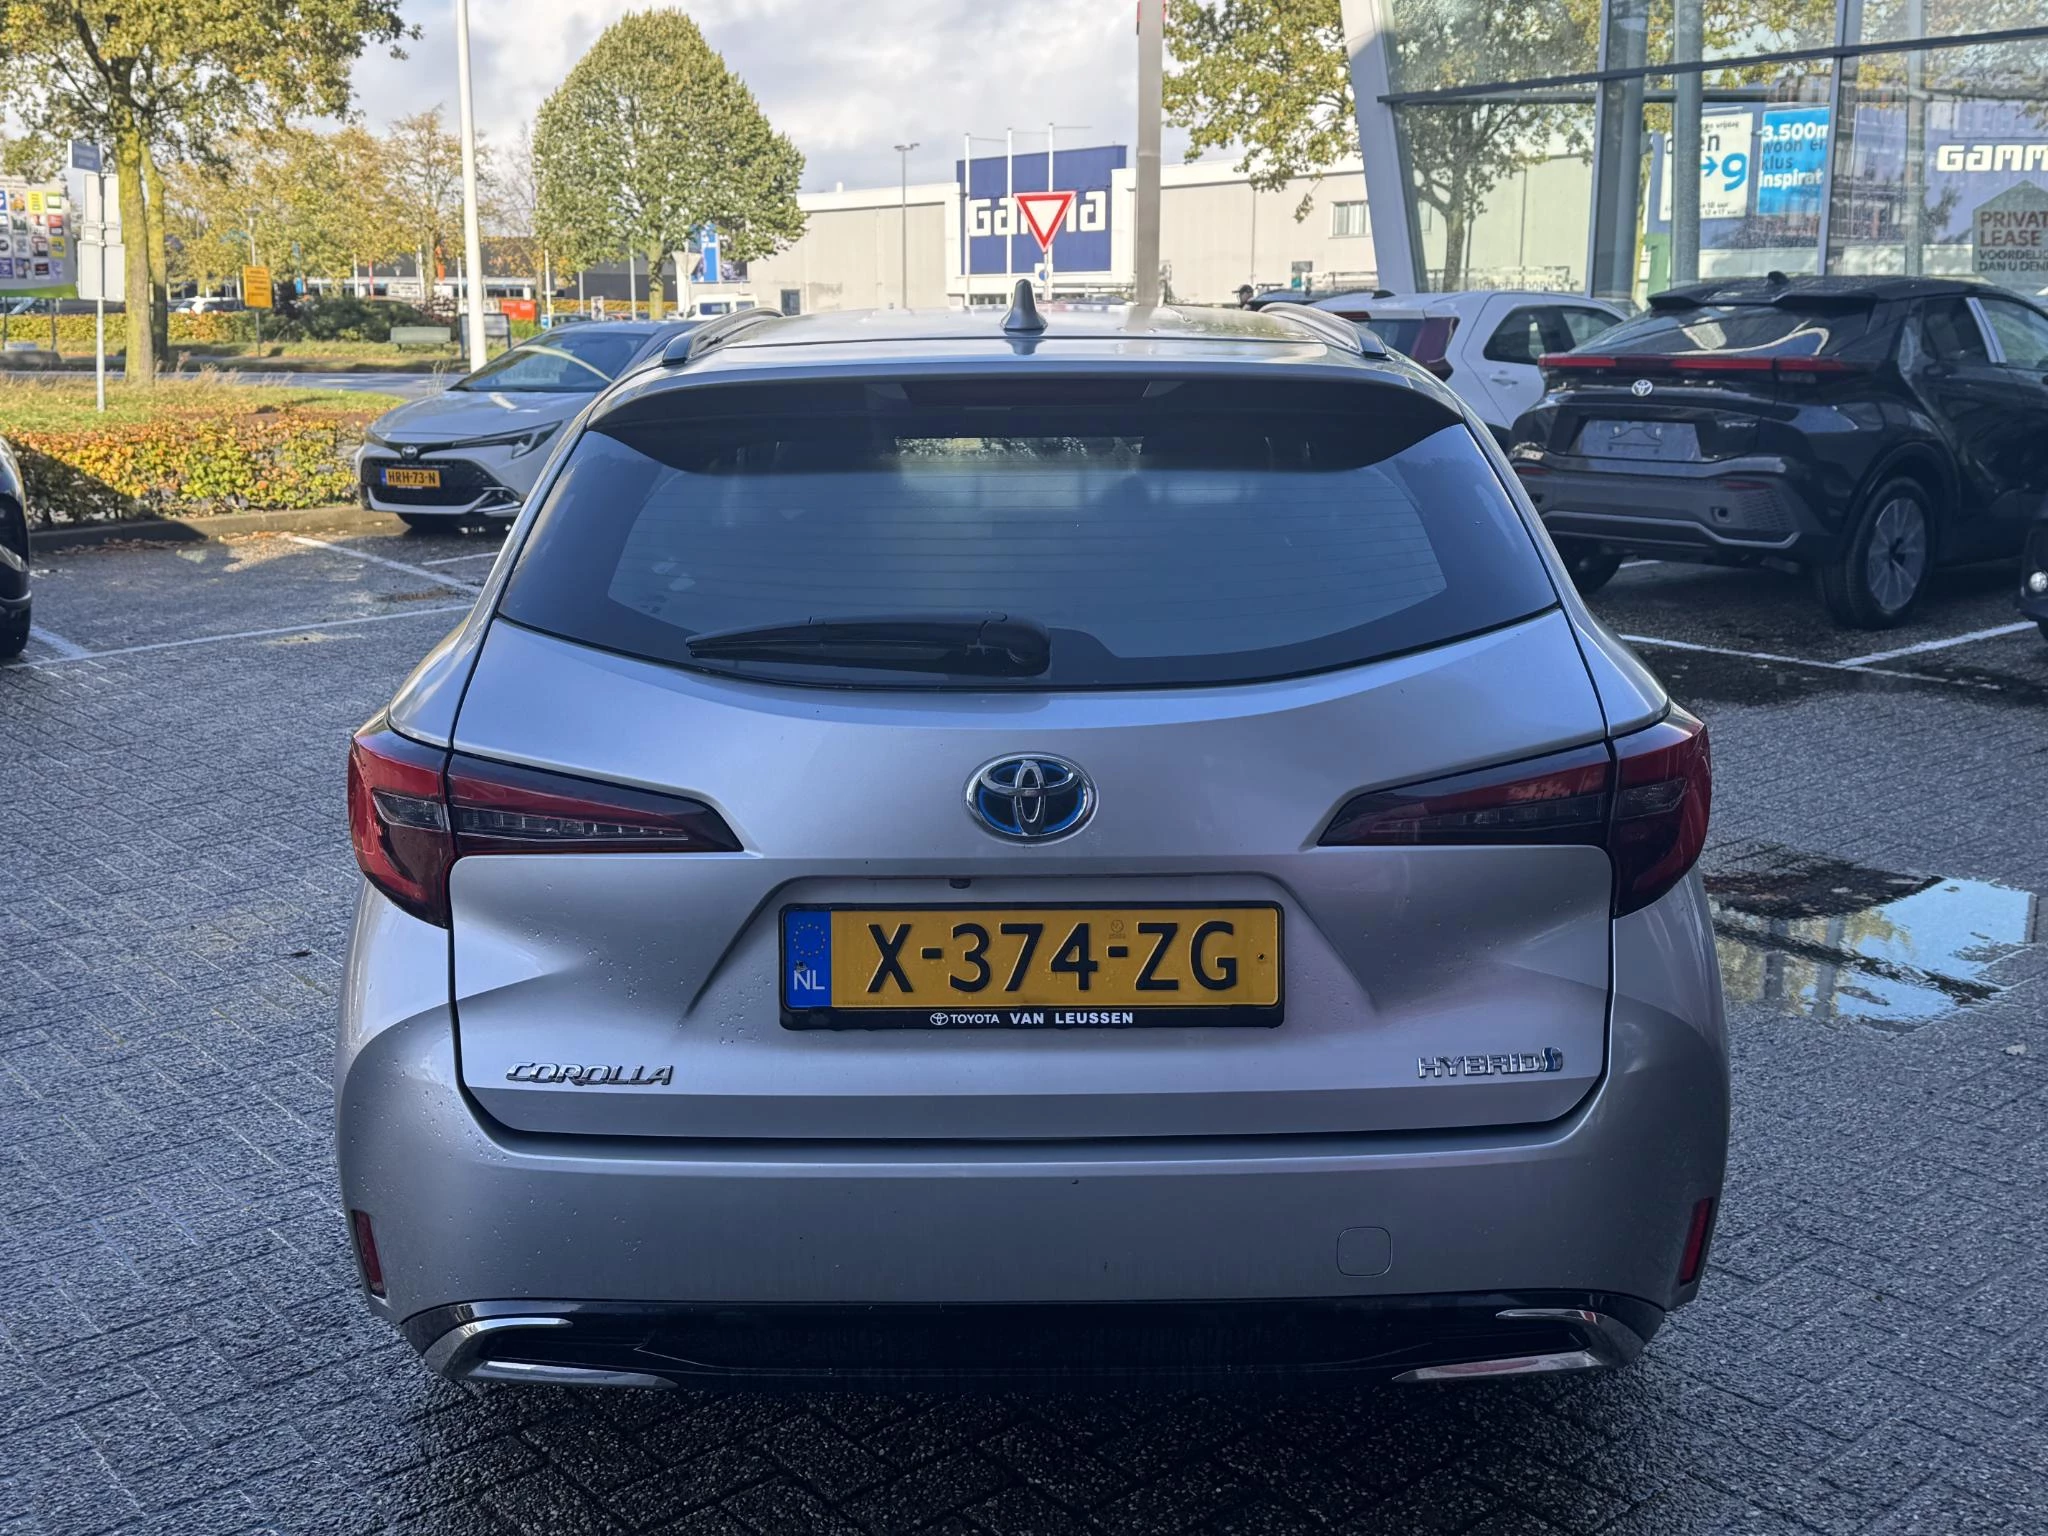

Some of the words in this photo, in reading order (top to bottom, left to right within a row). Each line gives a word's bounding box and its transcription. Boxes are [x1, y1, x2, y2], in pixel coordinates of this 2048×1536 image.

[970, 191, 1106, 237] GAA
[1981, 230, 2042, 247] LEASE
[1980, 261, 2006, 271] DAN
[866, 921, 1237, 992] X-374-ZG
[794, 970, 825, 990] NL
[950, 1014, 1000, 1024] TOYOTA
[1010, 1013, 1044, 1024] VAN
[1055, 1012, 1133, 1024] LEUSSEN
[506, 1062, 673, 1086] COROLLA
[1419, 1054, 1539, 1078] HYBRID
